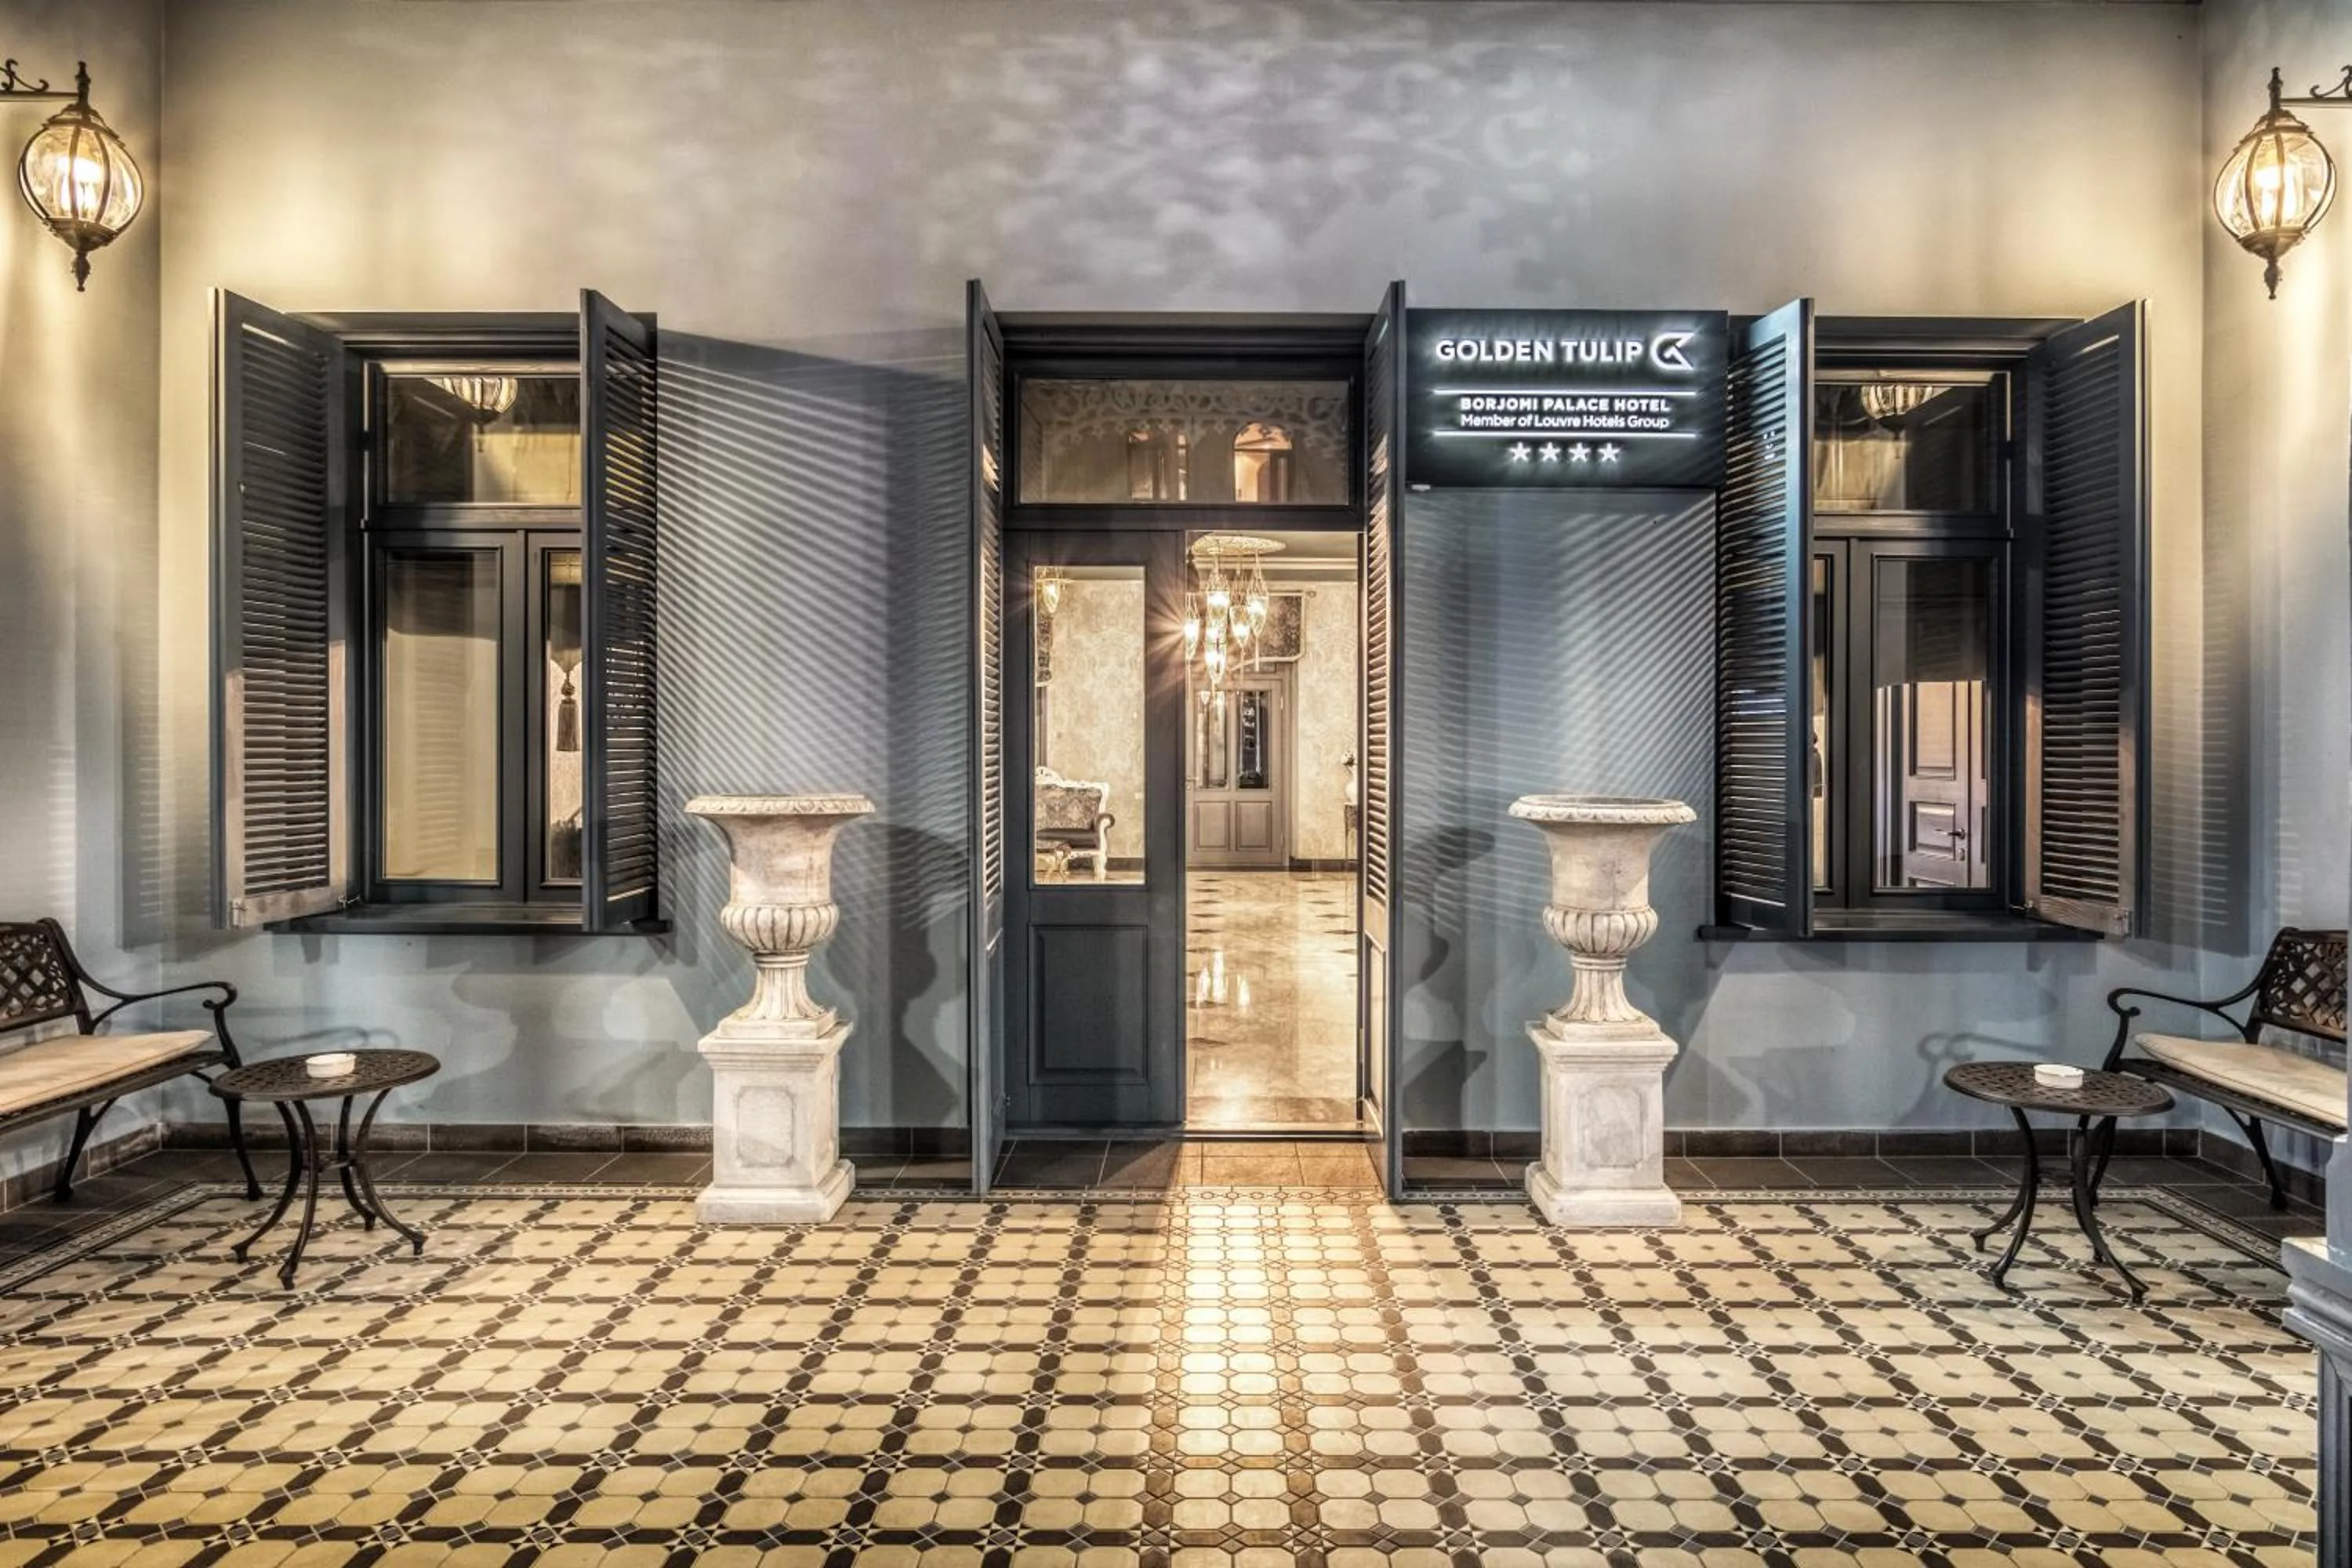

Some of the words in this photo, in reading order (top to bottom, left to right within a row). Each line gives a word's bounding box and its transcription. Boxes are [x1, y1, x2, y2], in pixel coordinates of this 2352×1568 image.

[1436, 340, 1554, 361] GOLDEN
[1563, 340, 1643, 361] TULIP
[1543, 398, 1609, 412] PALACE
[1615, 398, 1671, 412] HOTEL
[1461, 414, 1516, 427] Member
[1518, 414, 1533, 427] of
[1534, 415, 1581, 427] Louvre
[1583, 415, 1625, 428] Hotels
[1628, 416, 1670, 430] Group
